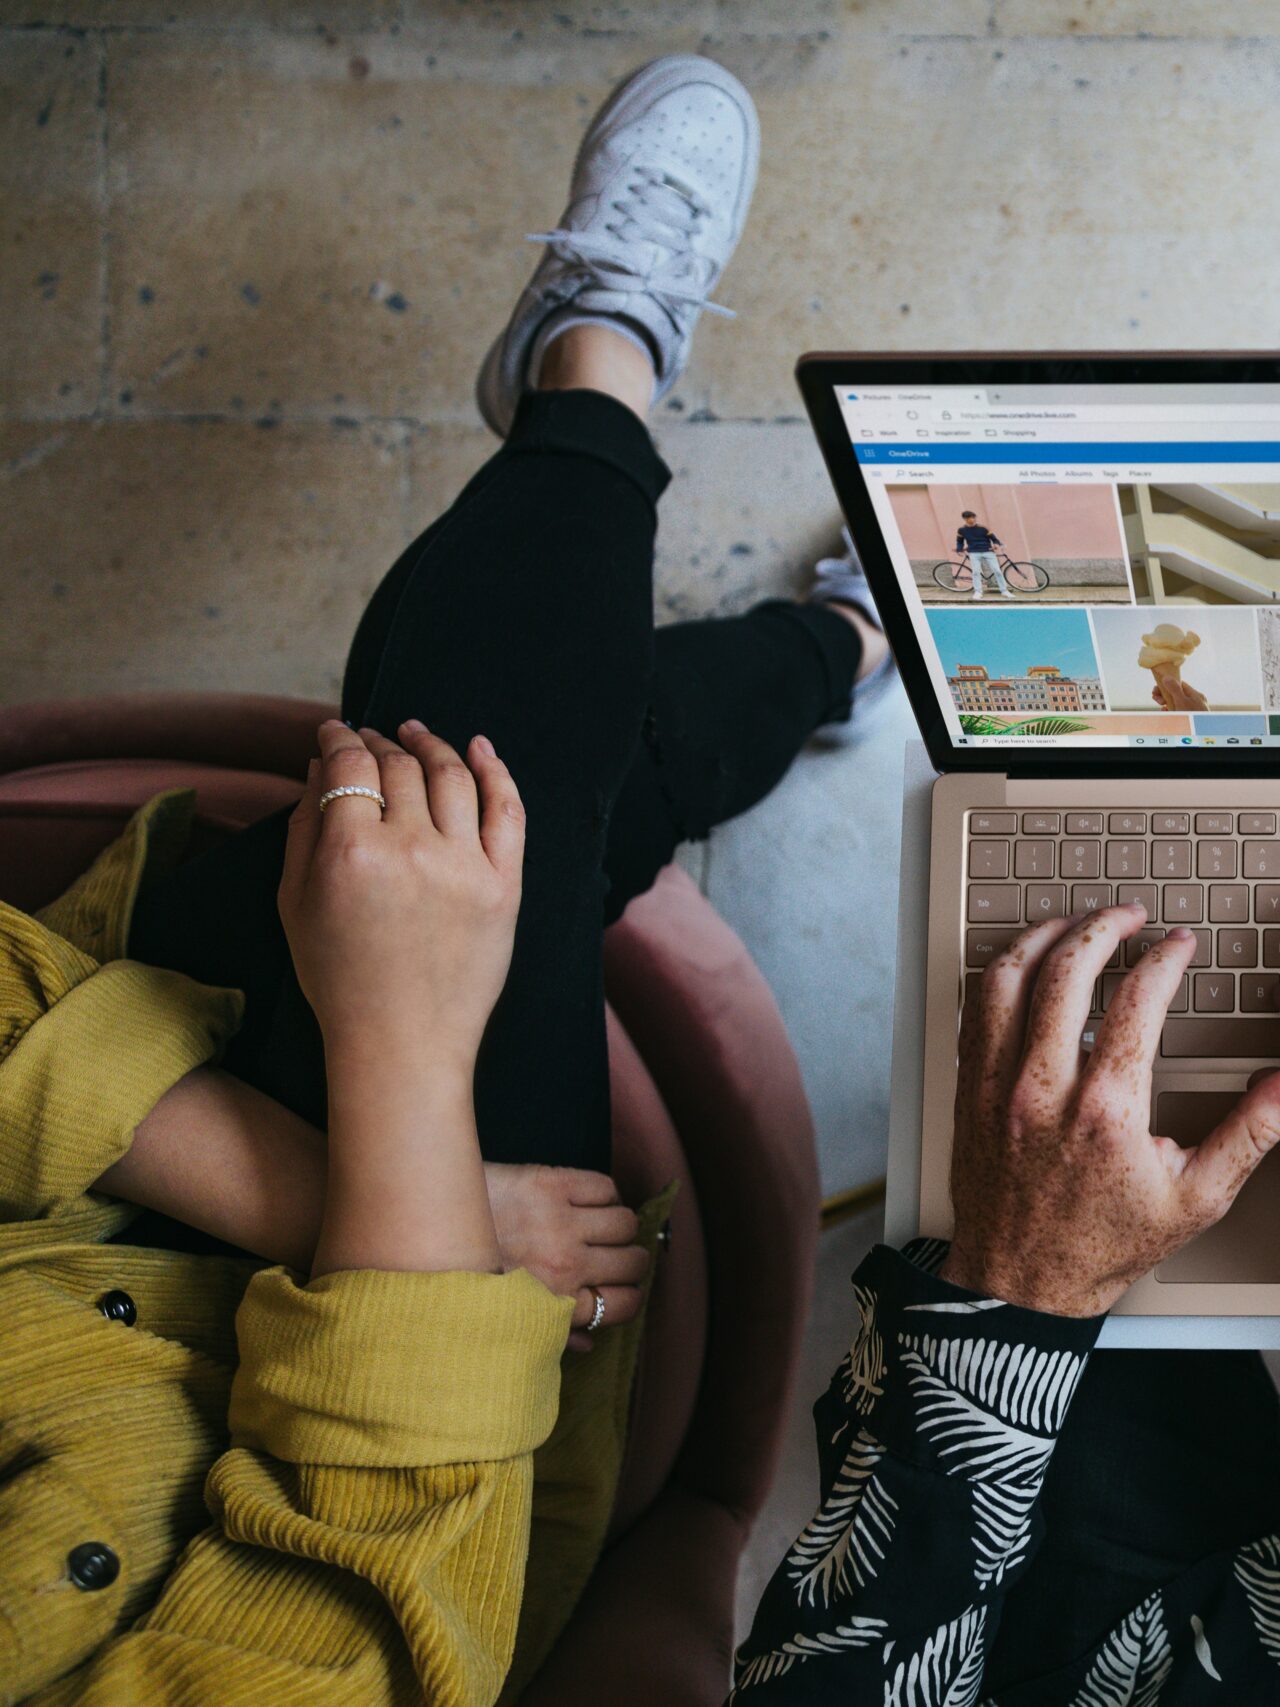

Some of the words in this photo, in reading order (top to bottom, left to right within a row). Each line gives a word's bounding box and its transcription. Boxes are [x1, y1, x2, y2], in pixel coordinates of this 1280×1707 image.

[1003, 430, 1037, 438] Shopping
[888, 450, 930, 458] OneDrive
[908, 470, 934, 478] Search
[1065, 470, 1093, 478] Albums
[1102, 470, 1119, 478] Tags
[979, 819, 990, 827] Esc
[1075, 847, 1085, 857] @
[1076, 862, 1083, 871] 2
[1122, 862, 1129, 871] 3
[1168, 862, 1175, 871] 4
[1214, 862, 1220, 871] 5
[1259, 862, 1266, 871] 6
[978, 899, 990, 908] Tab
[1040, 897, 1051, 911] Q
[1085, 897, 1098, 908] W
[1179, 898, 1187, 909] R
[1225, 898, 1232, 909] T
[1271, 898, 1279, 909] Y
[976, 944, 993, 952] Caps
[1233, 942, 1242, 953] G
[1210, 987, 1219, 998] V
[1257, 987, 1264, 998] B
